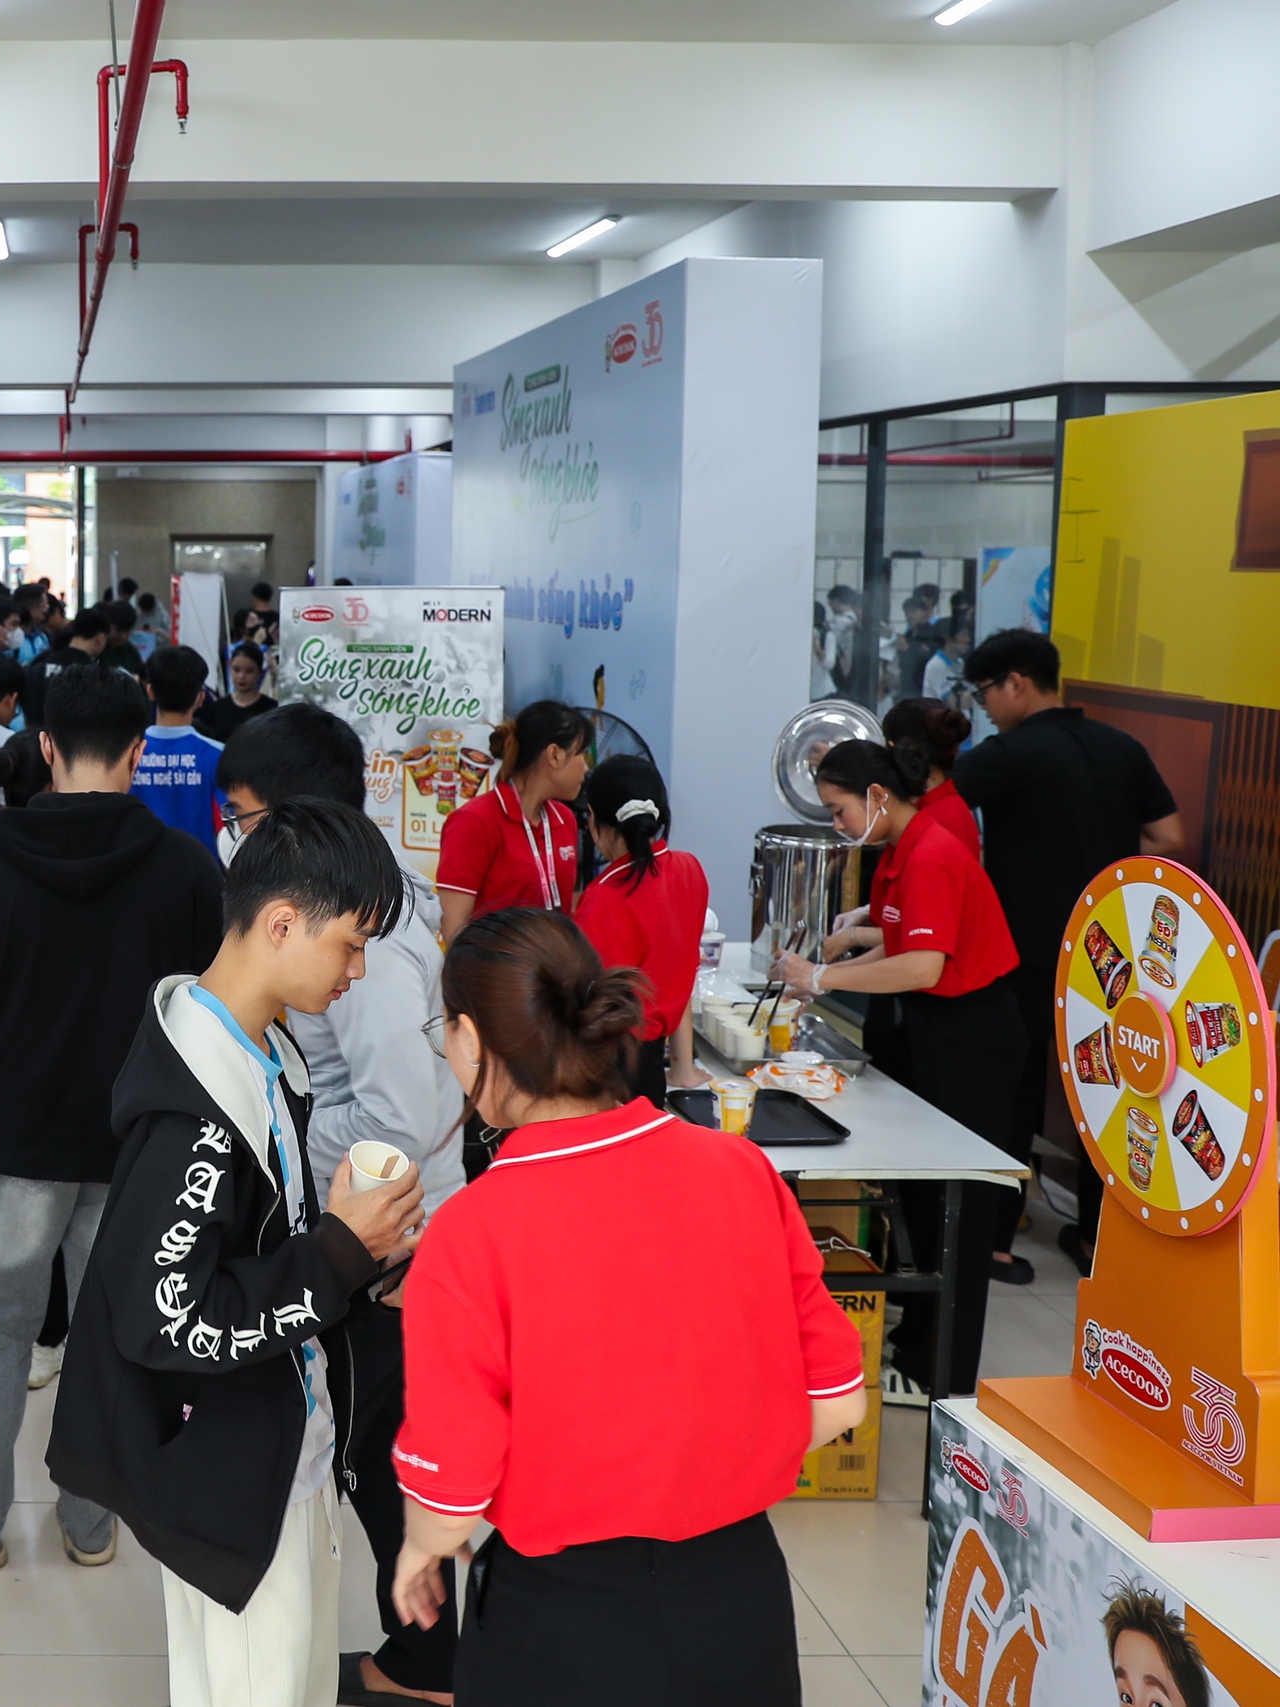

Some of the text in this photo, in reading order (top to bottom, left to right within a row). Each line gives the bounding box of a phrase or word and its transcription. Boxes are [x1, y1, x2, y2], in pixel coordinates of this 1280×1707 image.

[423, 608, 492, 622] MODERN
[299, 638, 433, 699] Sống xanh
[357, 683, 482, 735] sống khỏe
[181, 754, 196, 768] HỌC
[411, 820, 427, 833] 01
[1118, 1025, 1161, 1060] START
[1103, 1332, 1170, 1385] Cook happiness
[1182, 1439, 1243, 1486] ACECOOK VIETNAM
